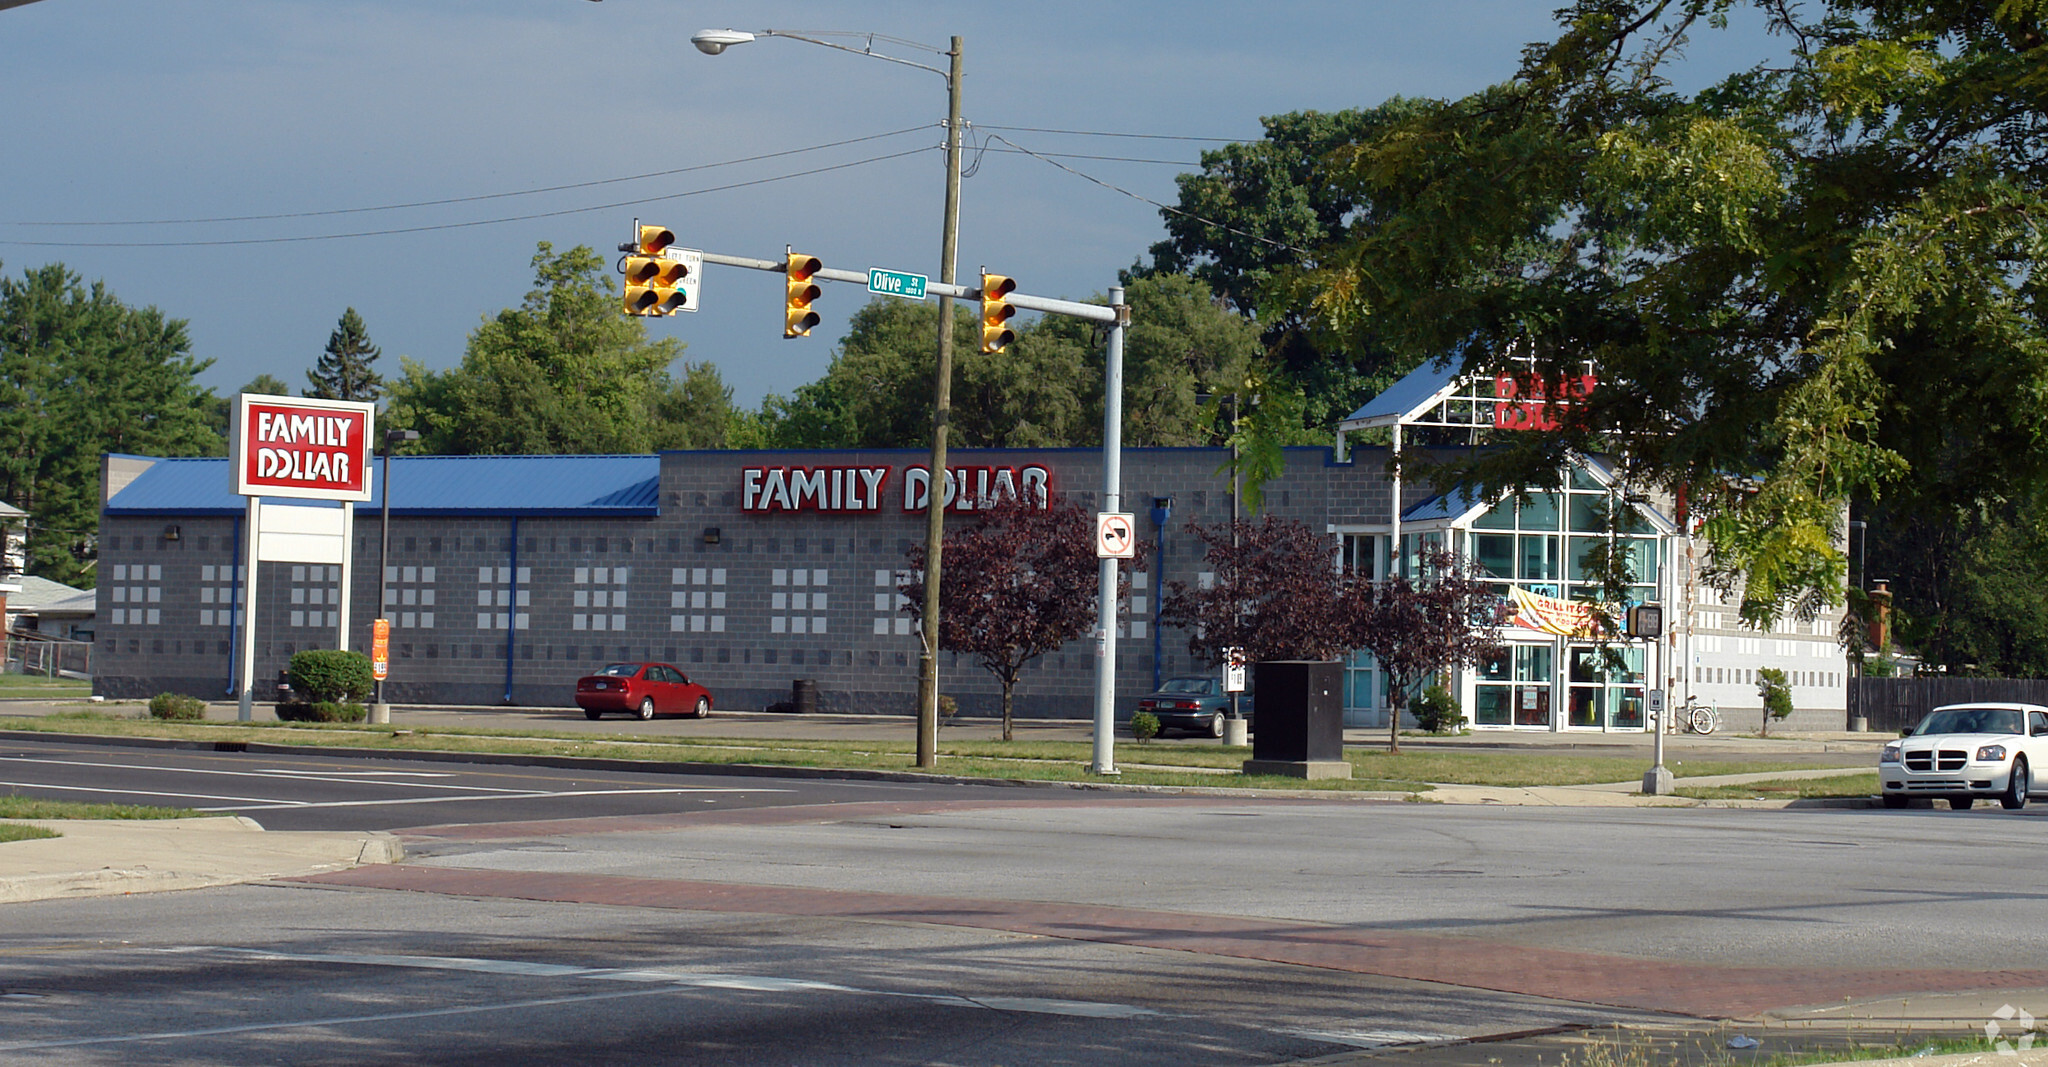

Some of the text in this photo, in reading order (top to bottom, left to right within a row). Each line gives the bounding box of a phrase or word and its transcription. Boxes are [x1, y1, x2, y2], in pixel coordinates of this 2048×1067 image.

[873, 272, 919, 292] Olive St
[258, 412, 353, 447] FAMILY
[257, 447, 349, 482] DOLLAR
[743, 468, 886, 511] FAMILY
[1537, 599, 1564, 611] GRILL
